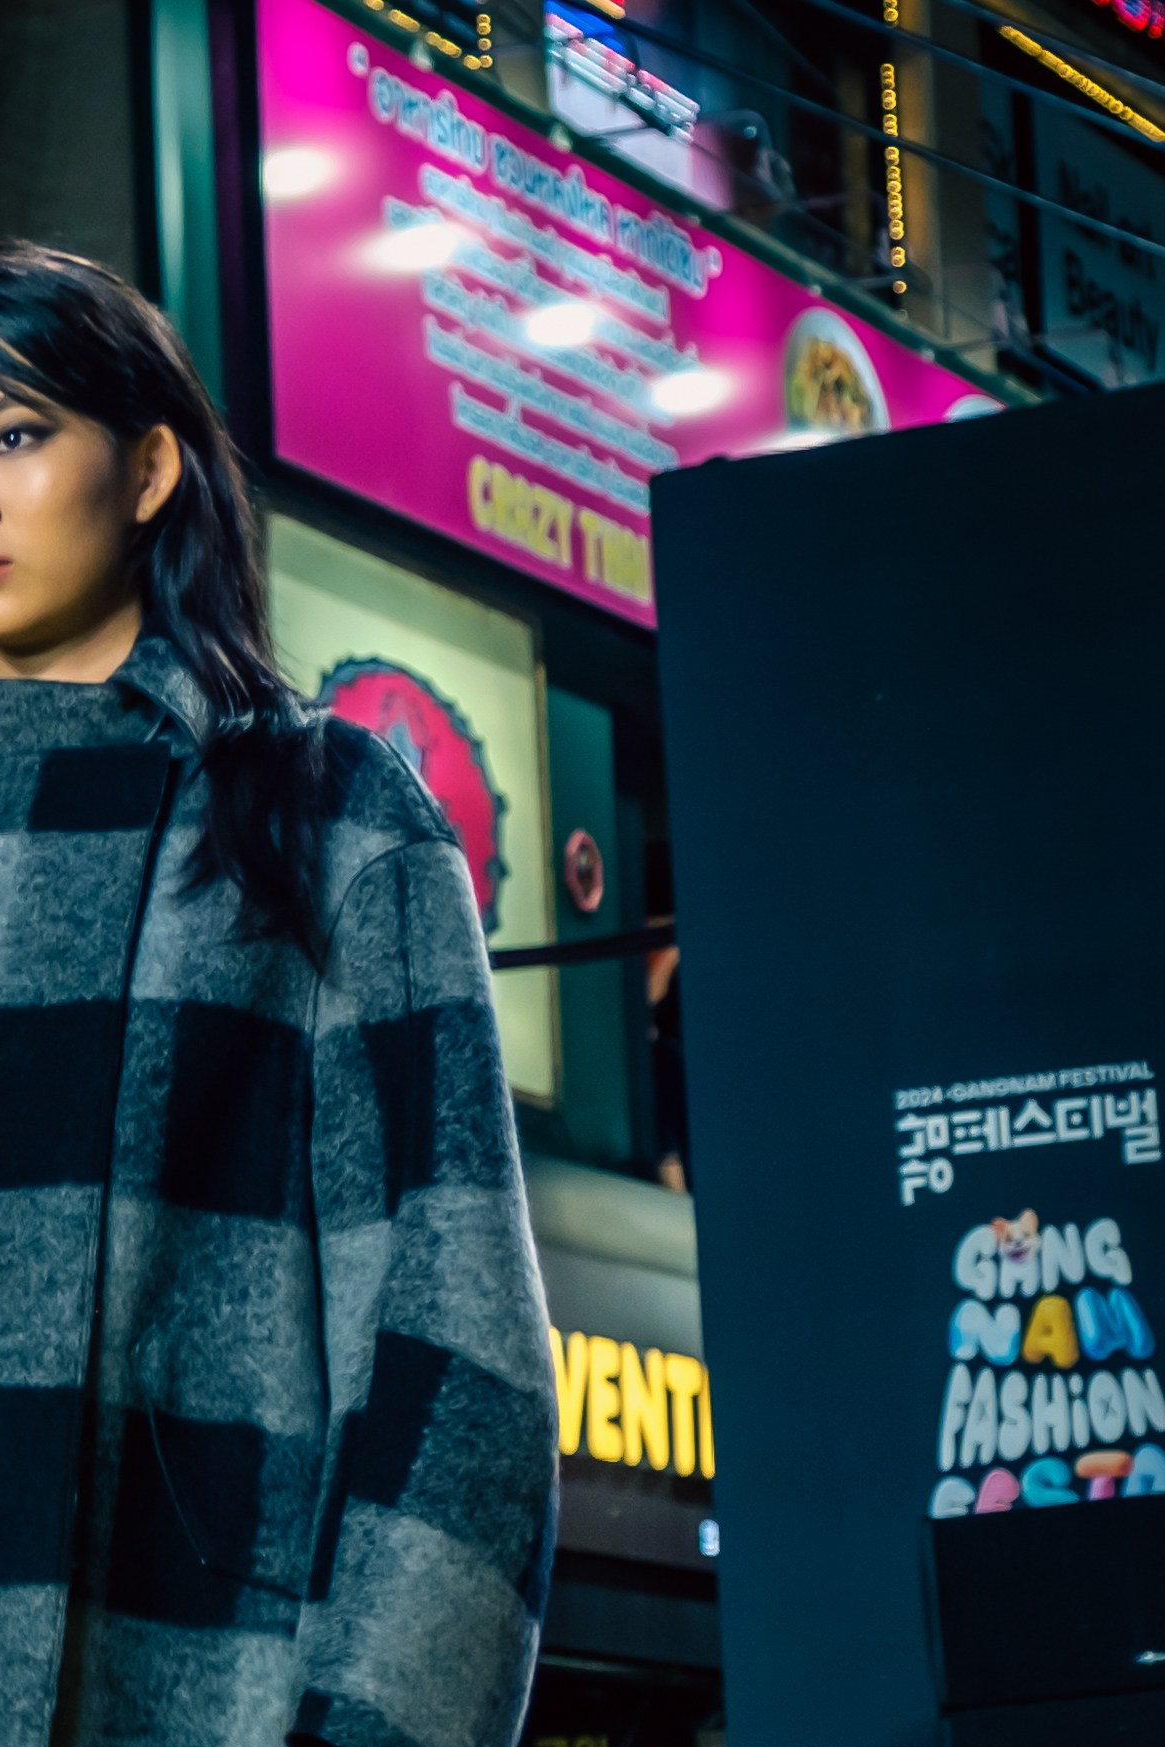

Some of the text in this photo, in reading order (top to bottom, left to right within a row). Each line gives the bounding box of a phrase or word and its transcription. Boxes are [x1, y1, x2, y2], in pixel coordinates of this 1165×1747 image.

[1057, 1059, 1157, 1089] FESTIVAL
[952, 1217, 1133, 1301] GANG
[948, 1286, 1157, 1368] NAM
